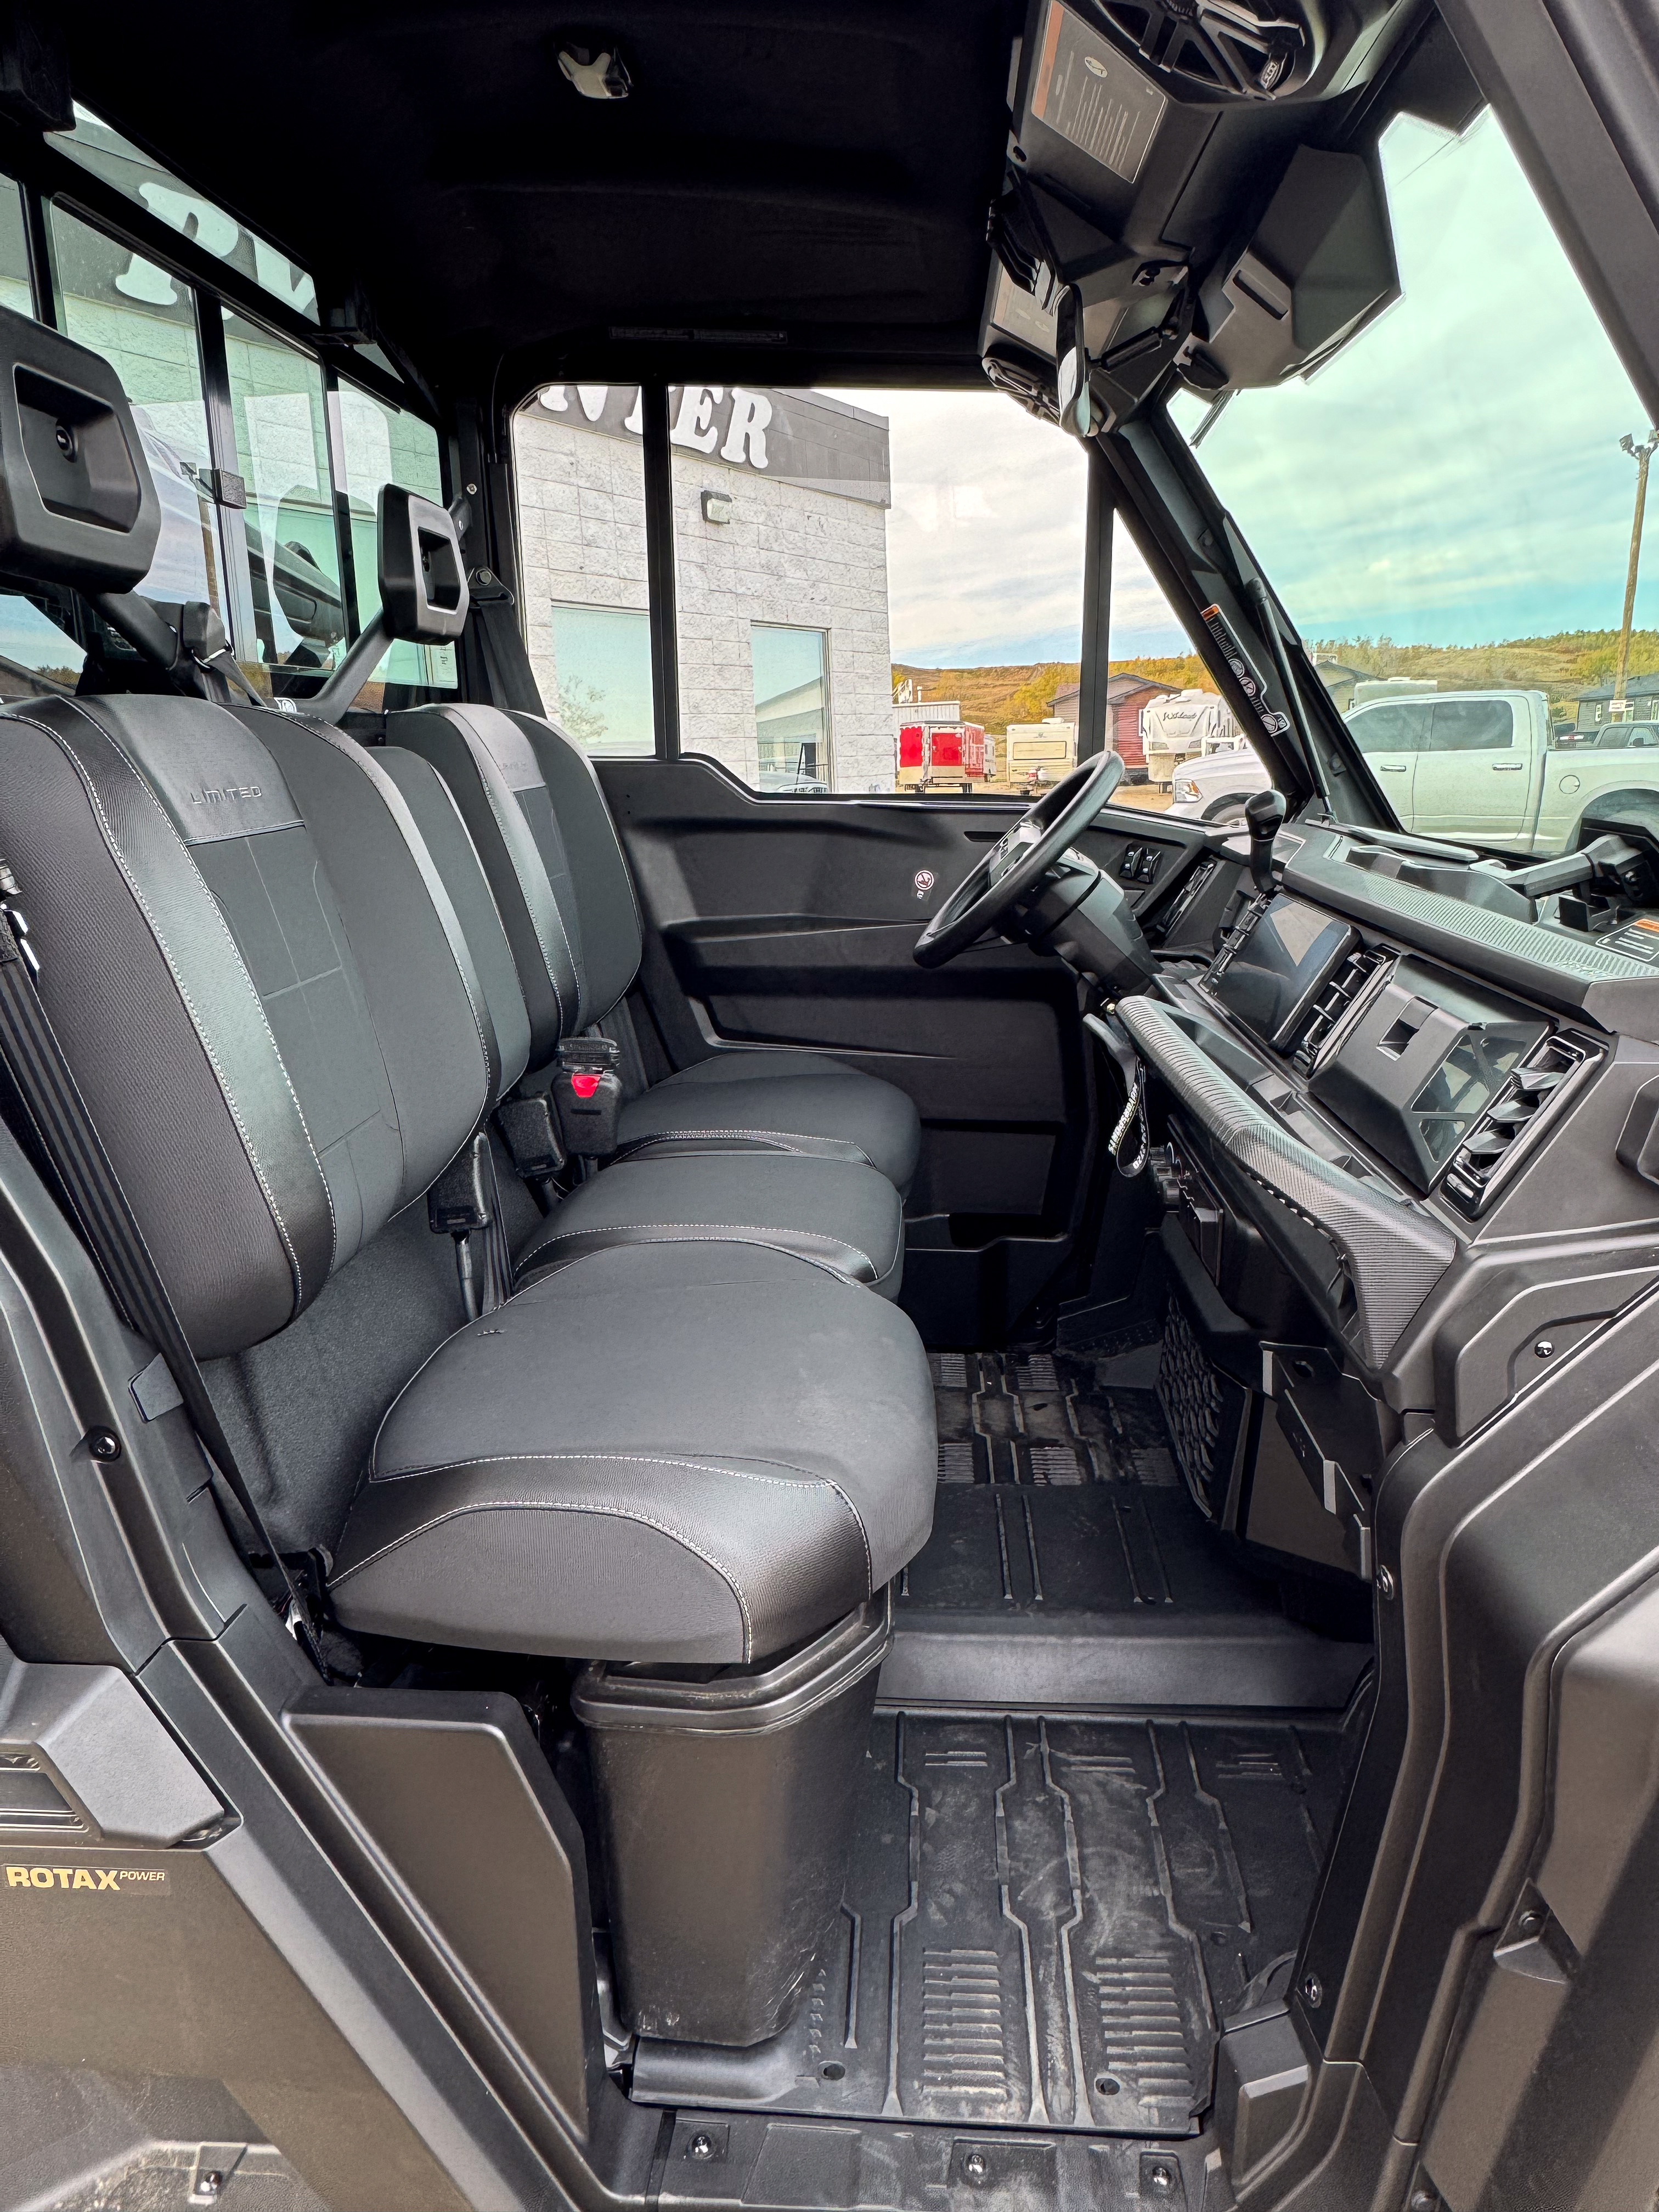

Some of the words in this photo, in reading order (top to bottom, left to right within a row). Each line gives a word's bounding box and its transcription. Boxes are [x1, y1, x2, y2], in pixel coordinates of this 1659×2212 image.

[190, 786, 262, 805] LIMITED
[5, 1866, 121, 1891] ROTAX
[120, 1871, 165, 1881] POWER
